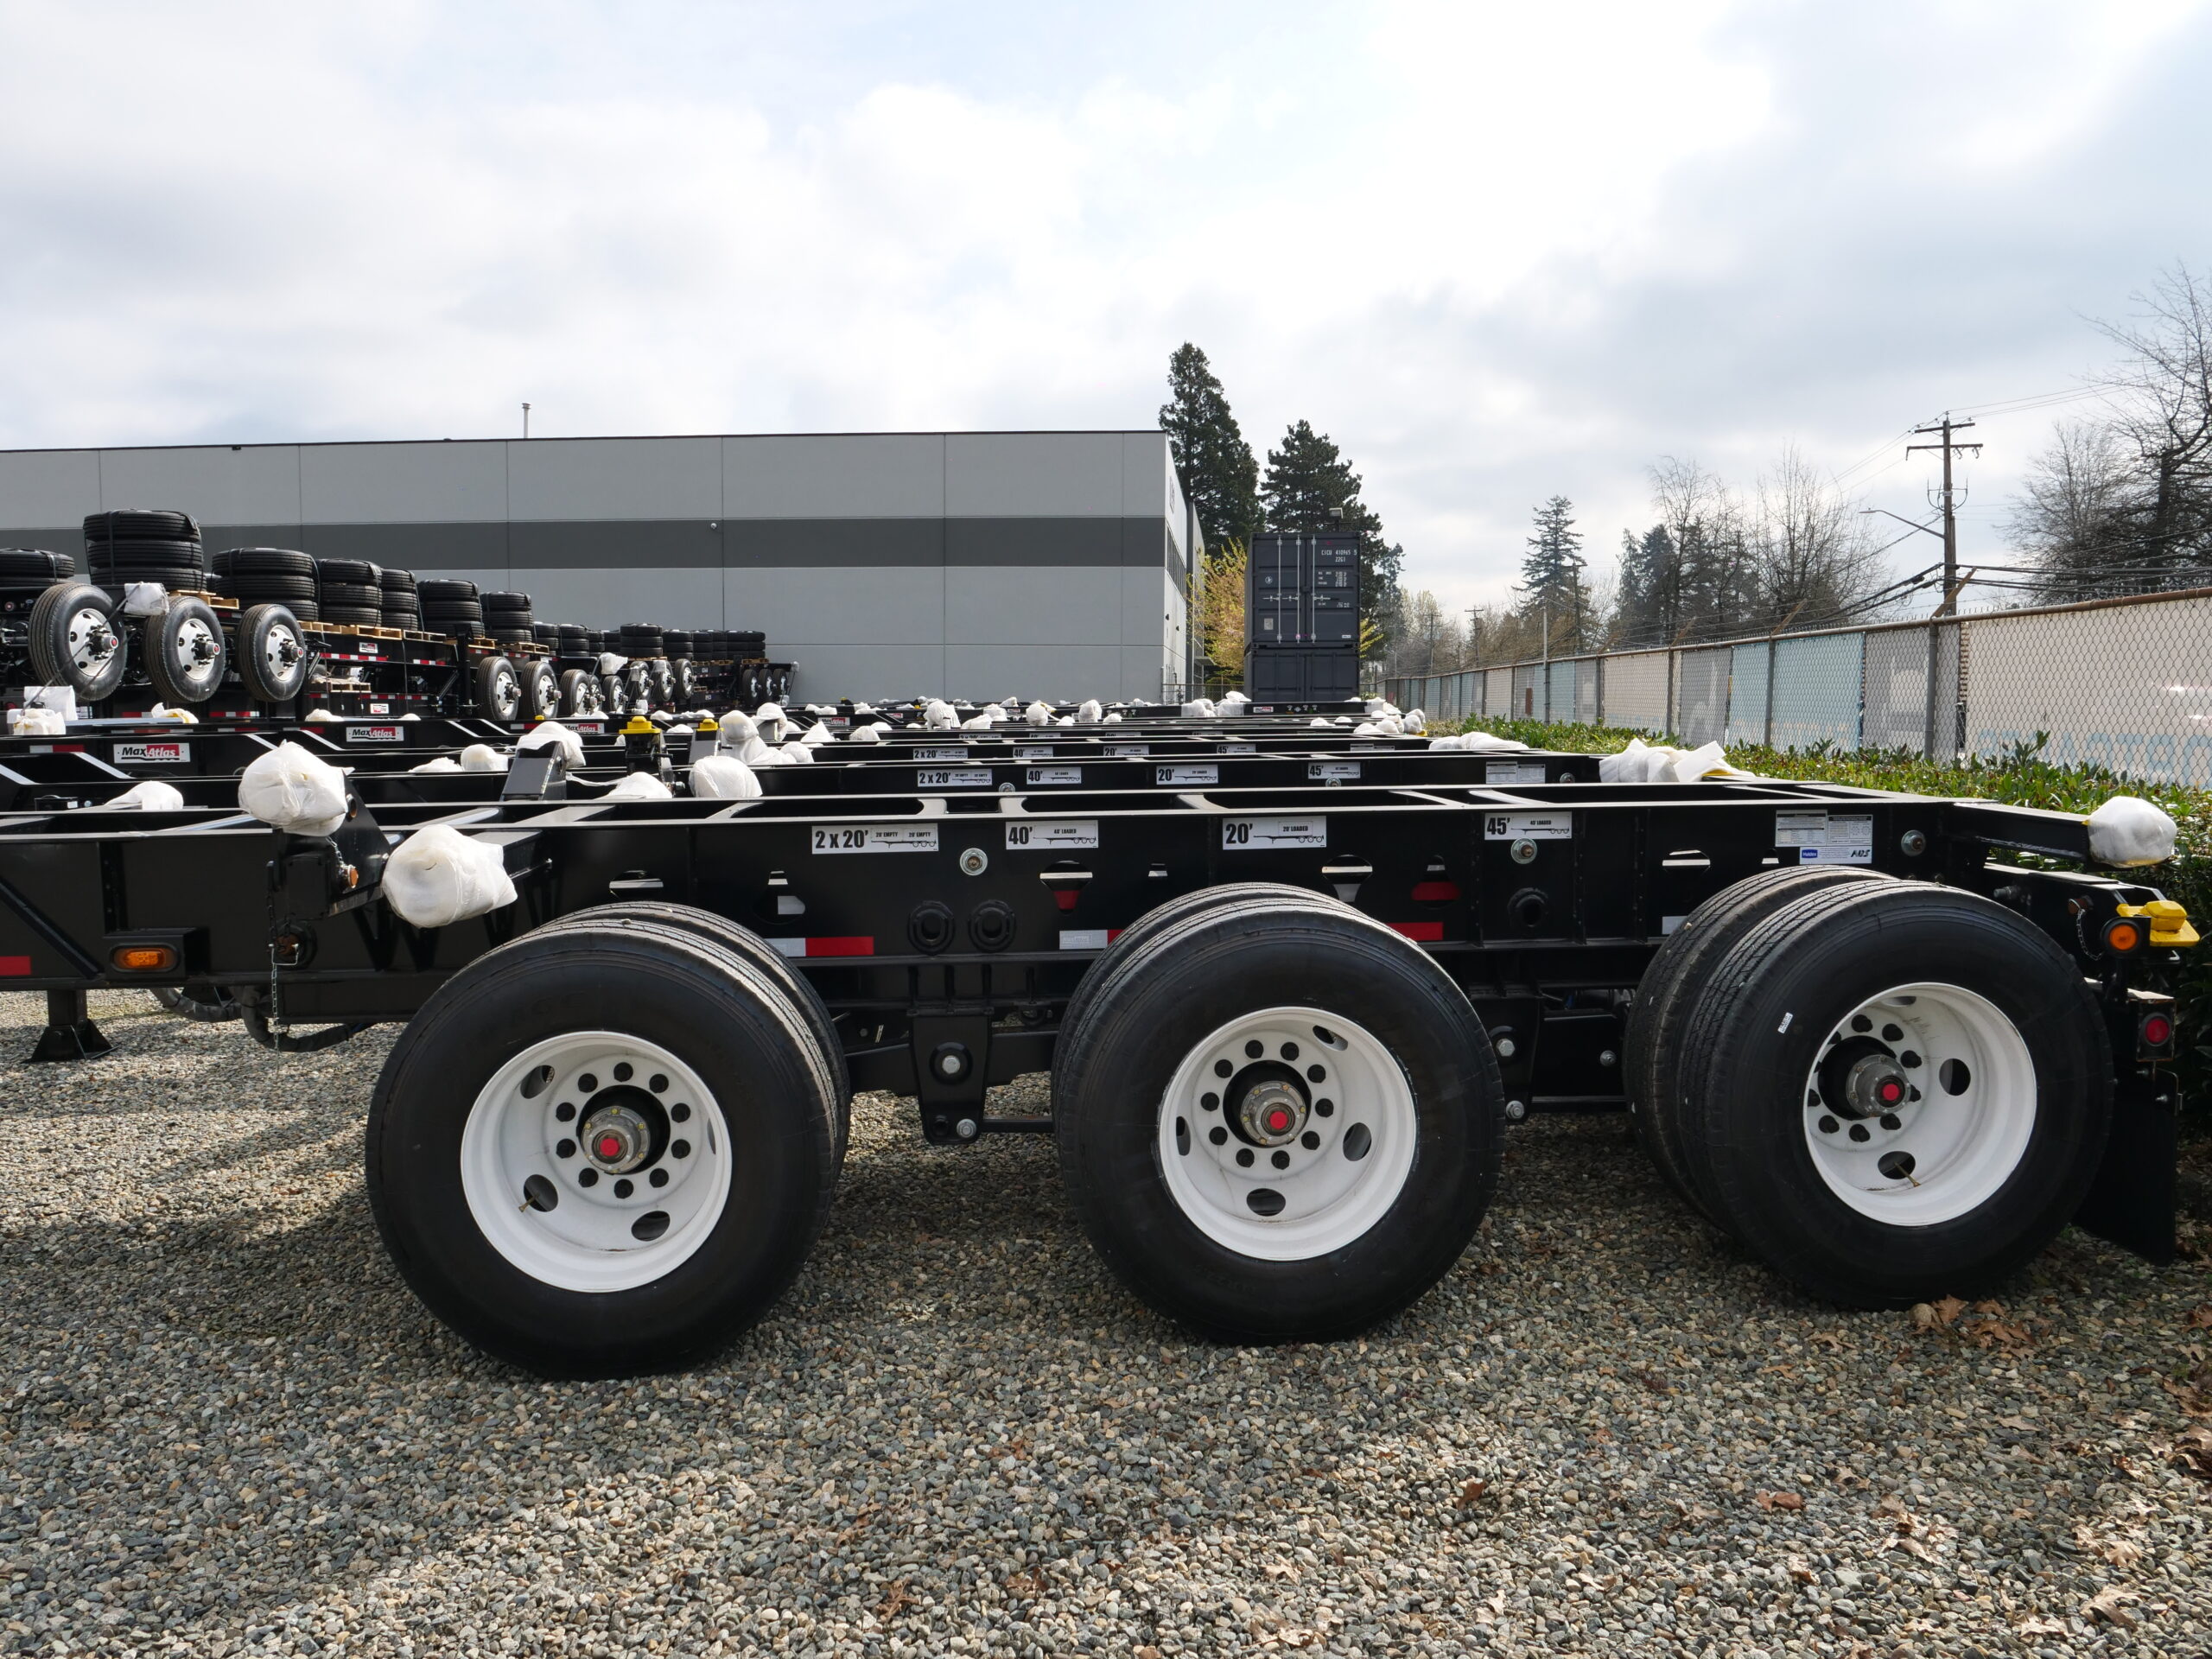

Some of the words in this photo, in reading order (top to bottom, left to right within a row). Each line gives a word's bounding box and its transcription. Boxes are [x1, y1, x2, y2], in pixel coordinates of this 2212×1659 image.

[122, 747, 176, 757] MaxAtlas
[1028, 770, 1043, 782] 40'
[1158, 768, 1175, 781] 20'
[1309, 765, 1324, 776] 45'
[918, 772, 925, 784] 2
[927, 774, 934, 783] x
[936, 772, 951, 783] 20'
[1487, 817, 1511, 835] 45'
[815, 830, 826, 849] 2
[830, 833, 839, 849] x
[842, 830, 869, 849] 20'
[1008, 827, 1033, 844] 40'
[1225, 823, 1254, 844] 20'
